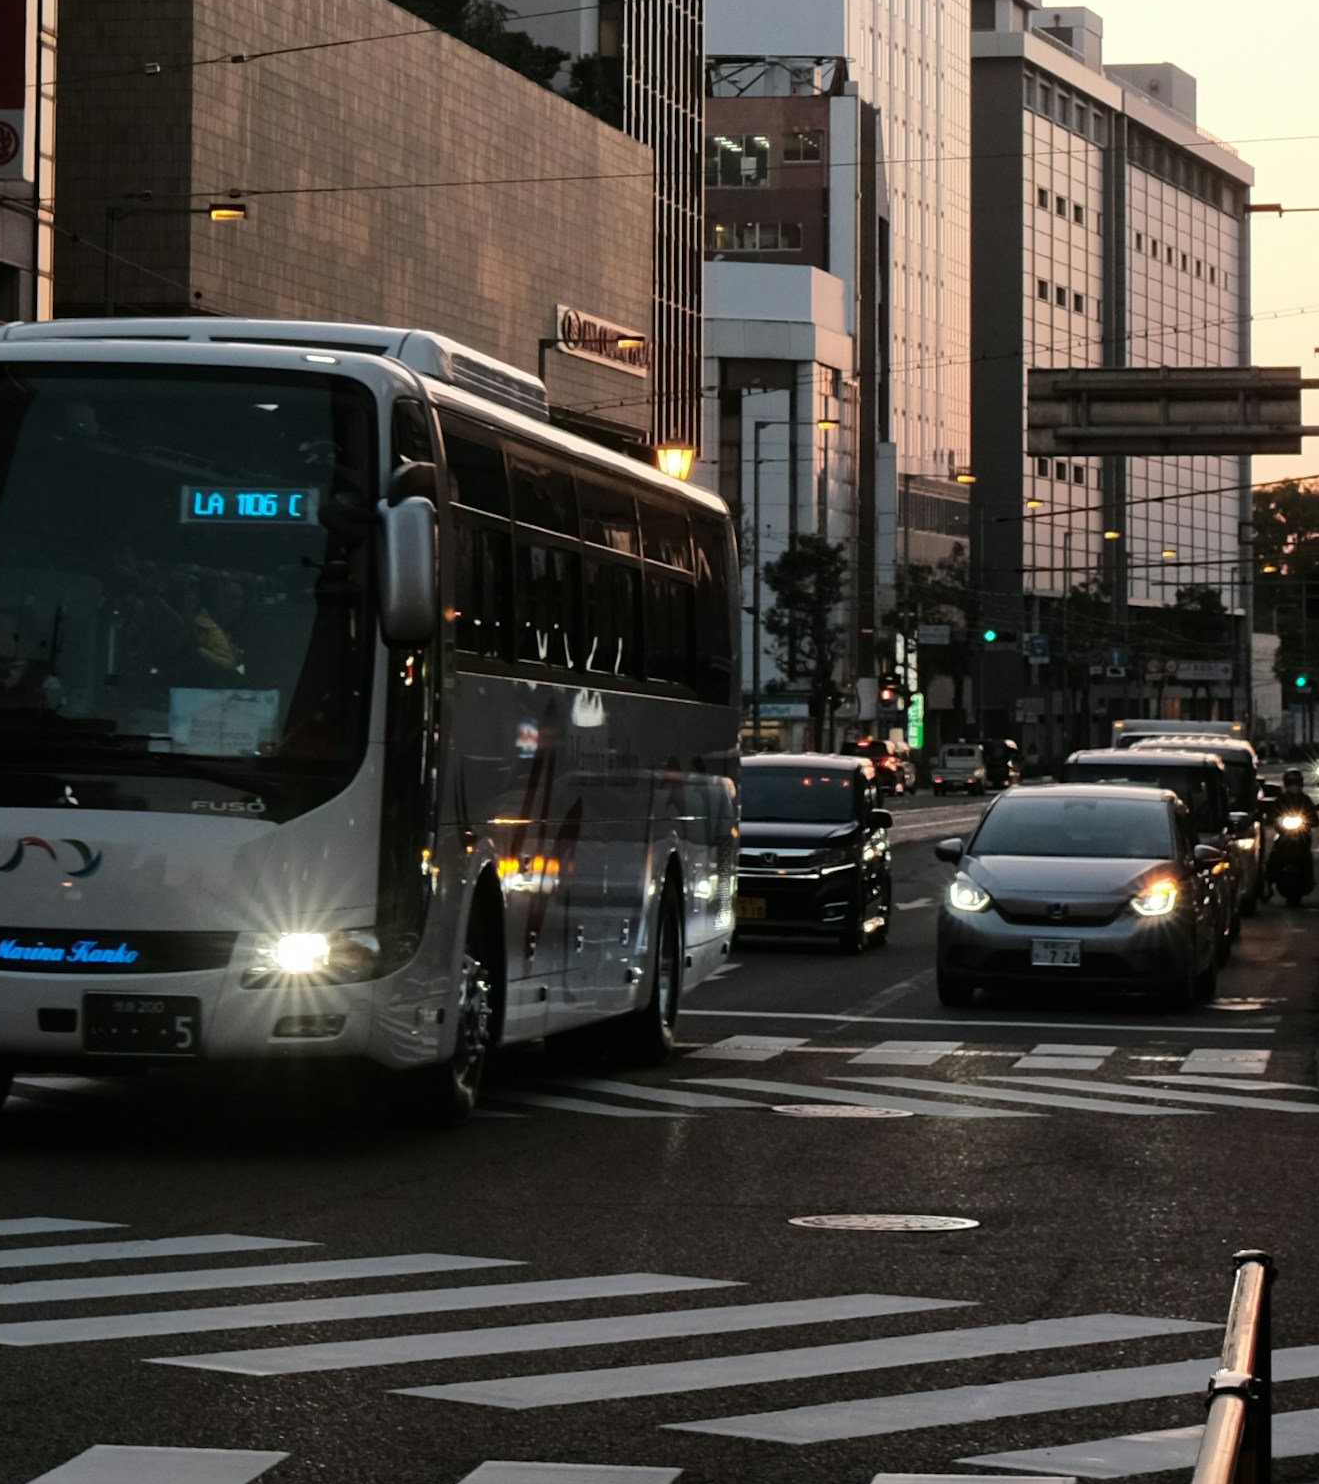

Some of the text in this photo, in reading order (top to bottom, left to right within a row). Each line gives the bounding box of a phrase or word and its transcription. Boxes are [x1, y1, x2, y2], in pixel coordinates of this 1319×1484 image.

[193, 491, 225, 517] LA
[191, 799, 267, 814] FUSO
[66, 939, 141, 965] Kanko
